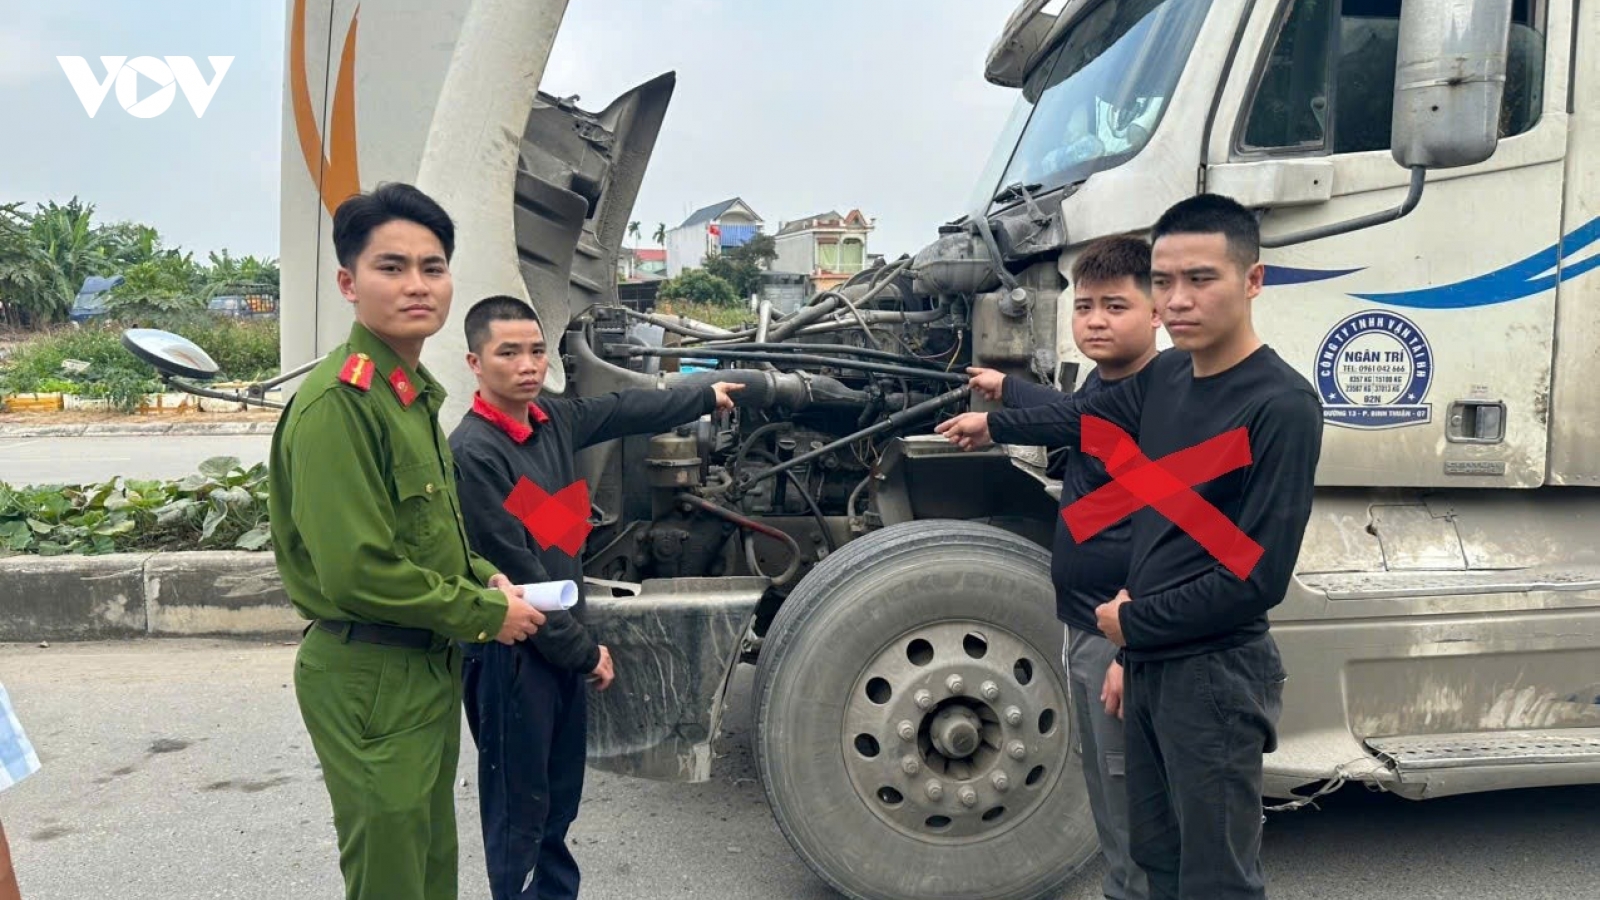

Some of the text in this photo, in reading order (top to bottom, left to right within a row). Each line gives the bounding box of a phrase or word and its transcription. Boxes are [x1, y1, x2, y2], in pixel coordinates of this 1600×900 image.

[1350, 317, 1384, 331] TNHH
[1334, 327, 1349, 342] TY
[1409, 337, 1425, 358] TẢI
[1319, 343, 1338, 377] CÔNG
[1345, 349, 1404, 362] NGÂN TRÍ
[1416, 361, 1426, 377] HH
